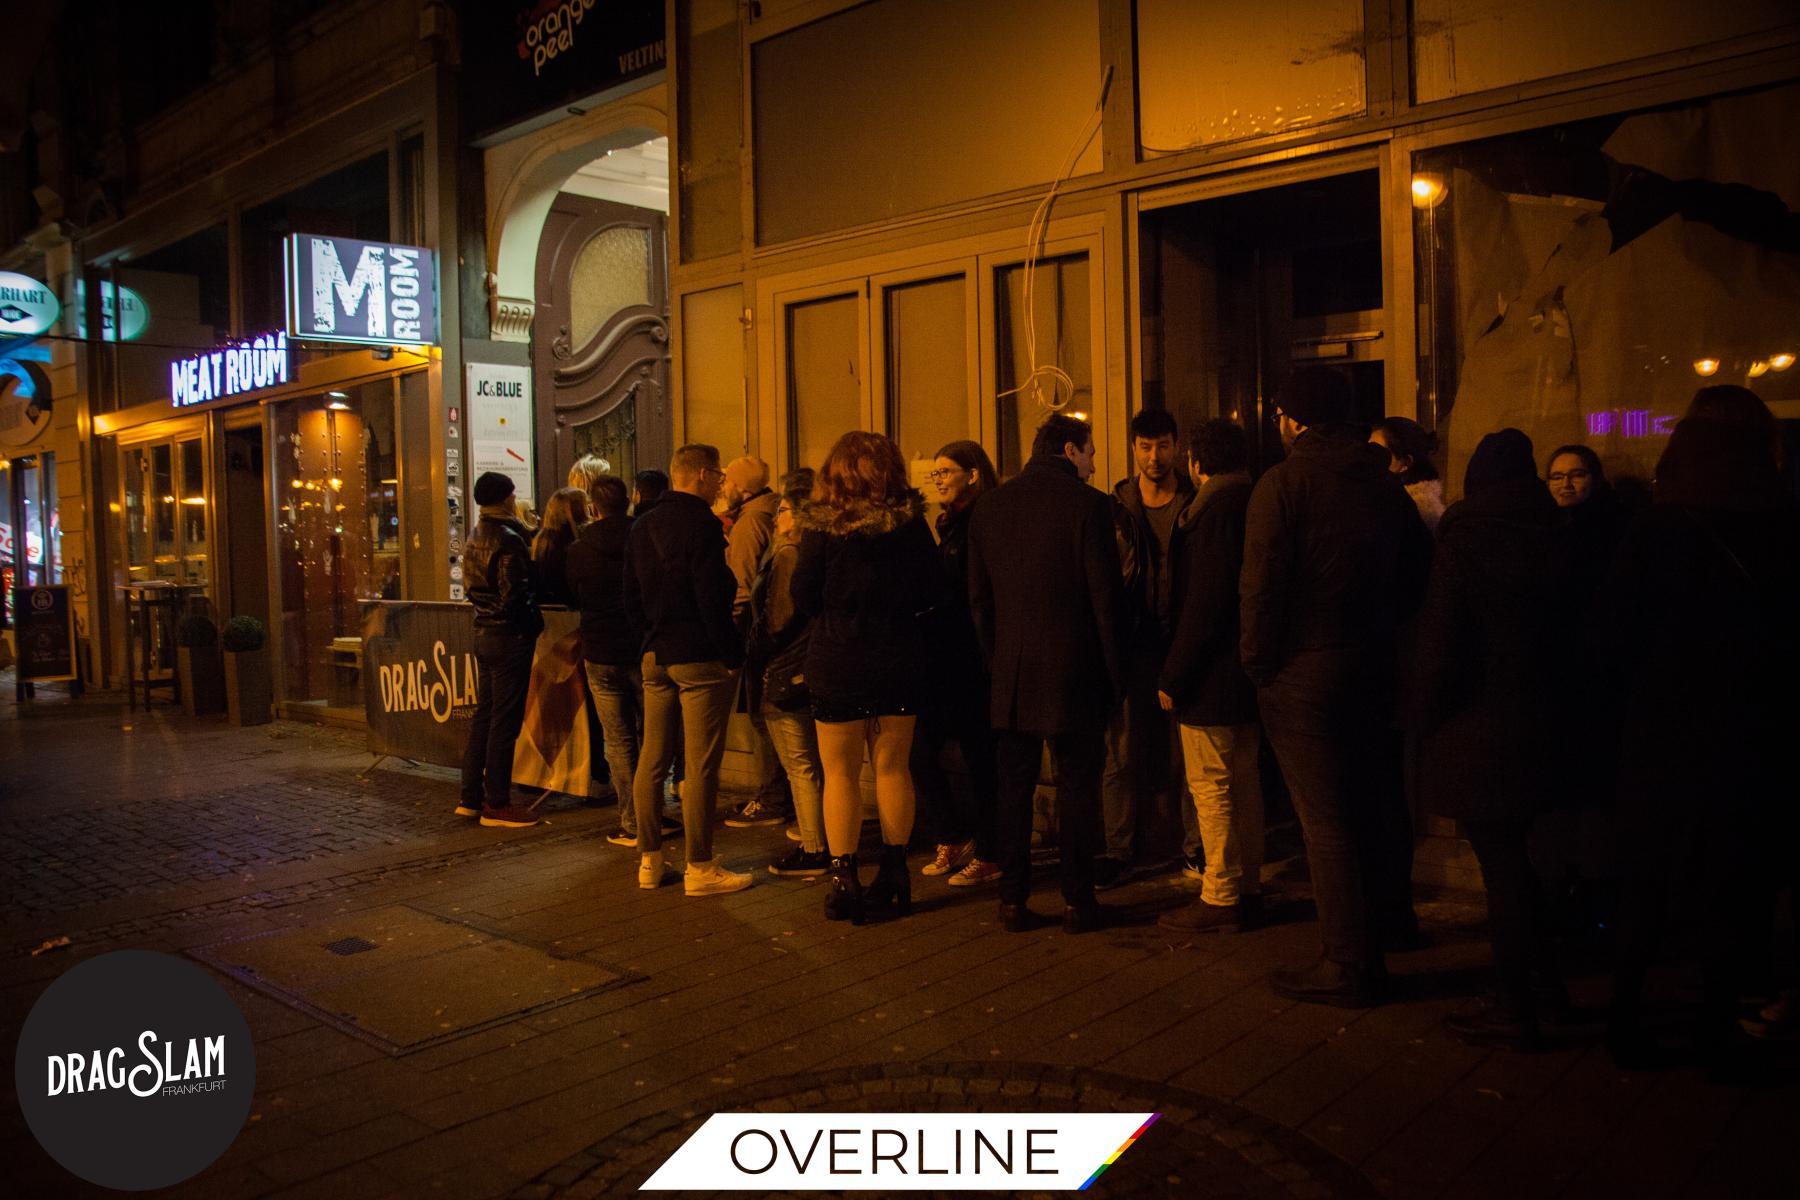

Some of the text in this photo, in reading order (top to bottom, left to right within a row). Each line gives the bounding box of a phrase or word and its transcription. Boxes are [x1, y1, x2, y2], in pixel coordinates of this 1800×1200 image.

[534, 29, 574, 78] peel
[311, 238, 388, 338] M
[389, 247, 421, 340] ROOM
[171, 331, 287, 408] MEAT ROOM
[476, 379, 523, 398] JC&BLUE
[379, 640, 480, 723] DRAGSLA
